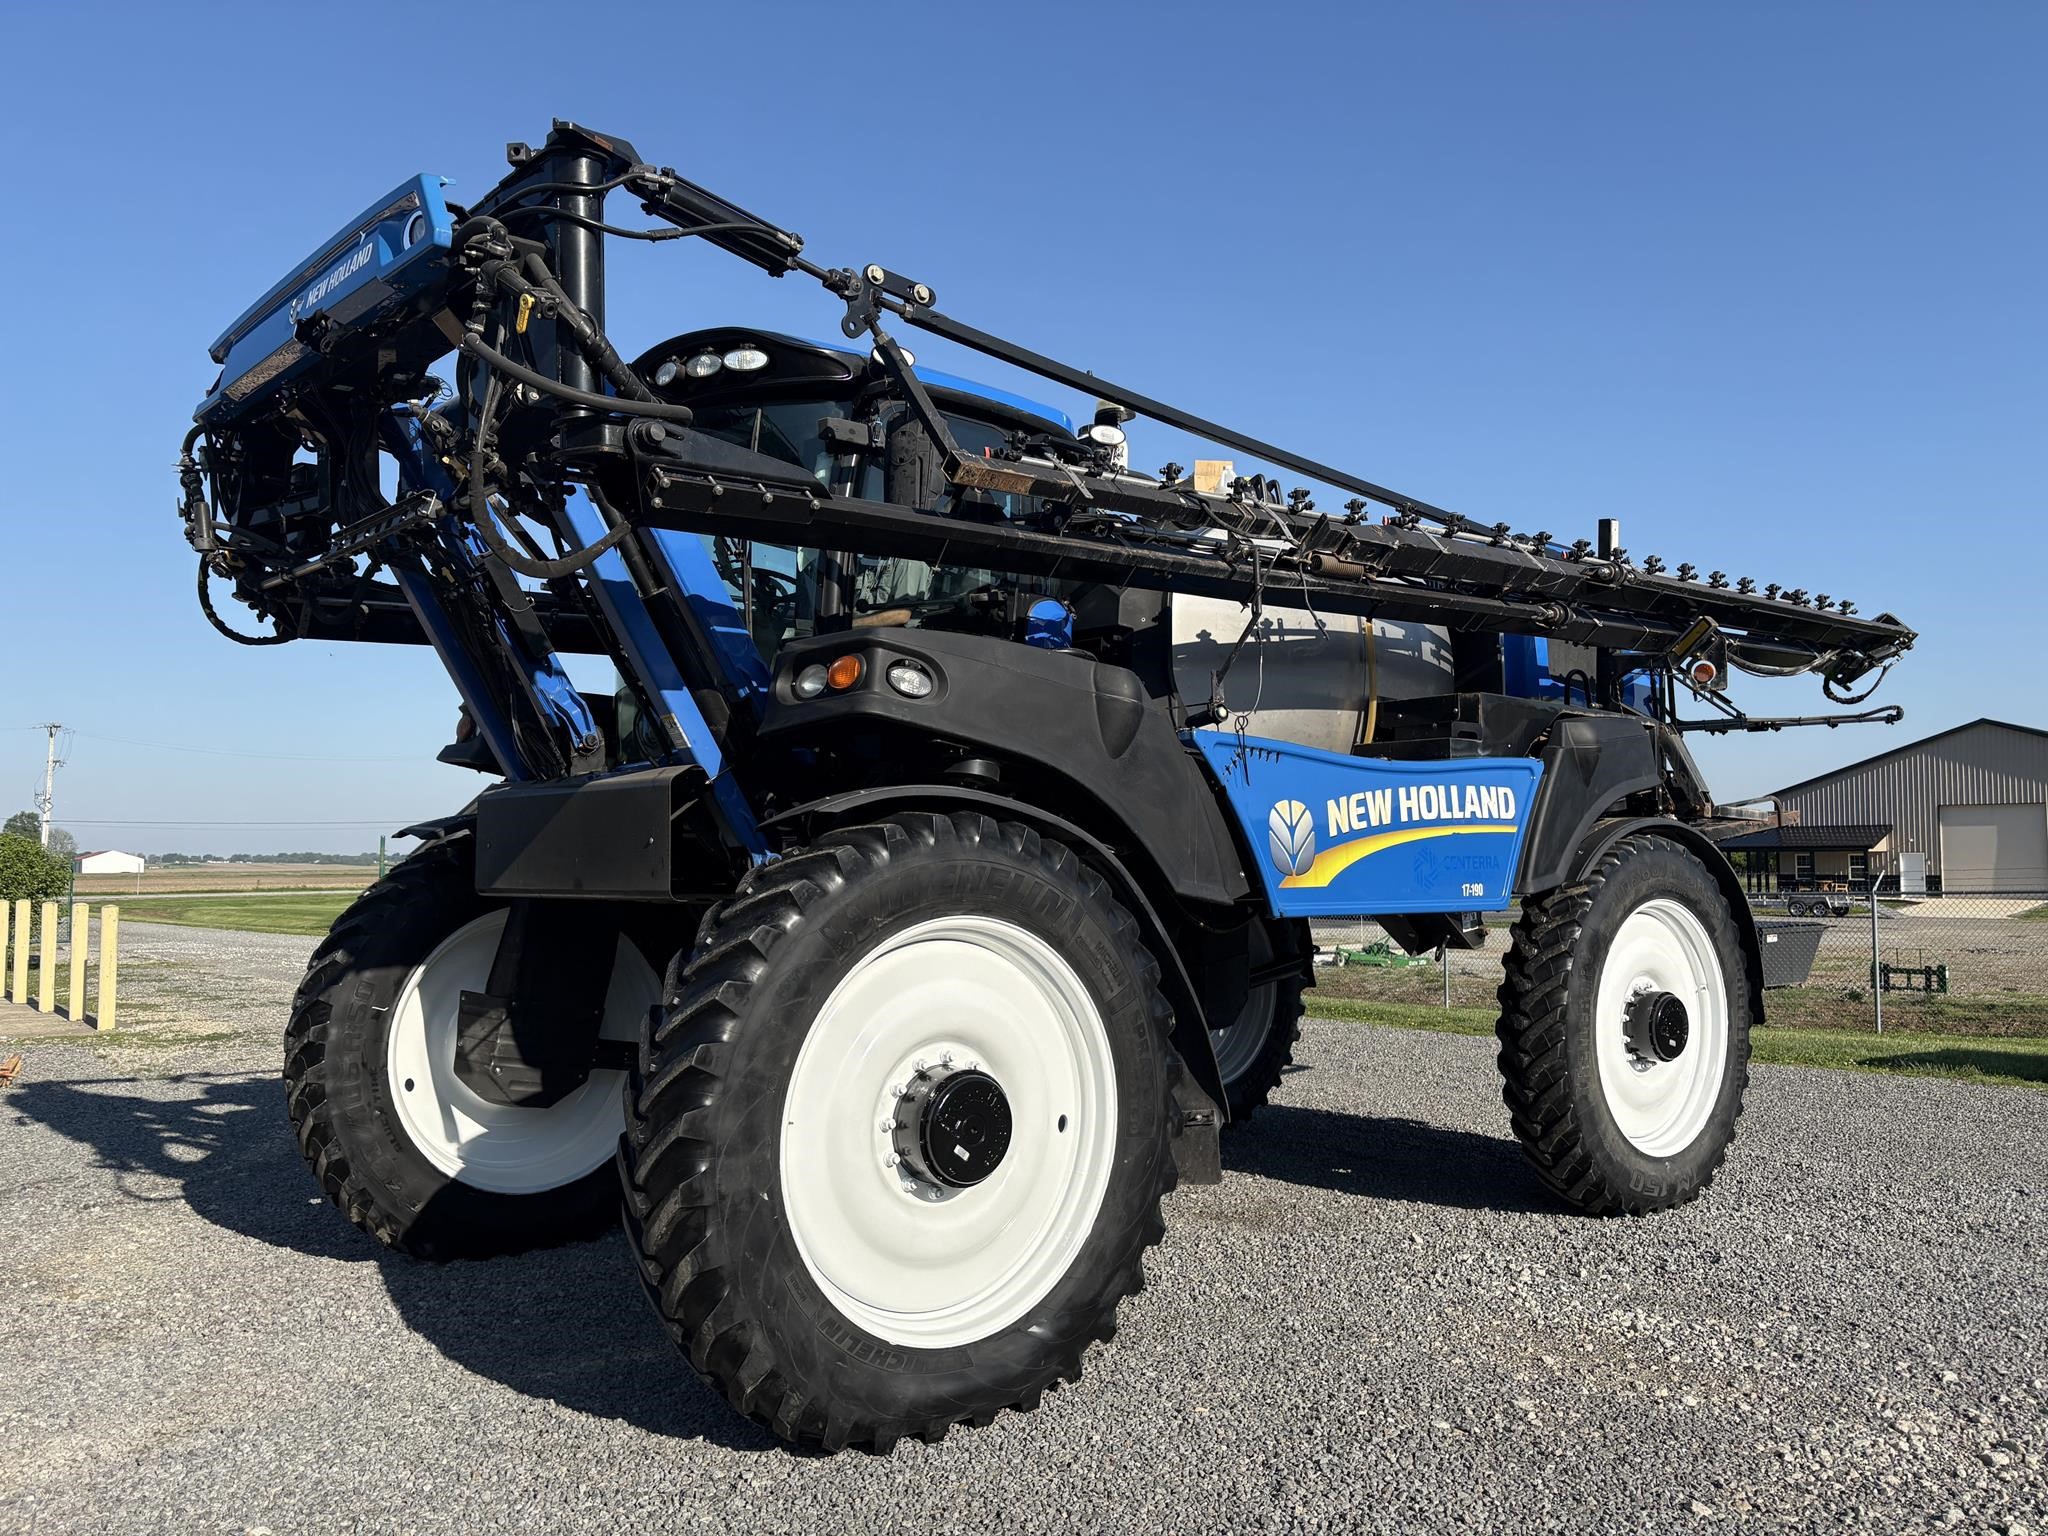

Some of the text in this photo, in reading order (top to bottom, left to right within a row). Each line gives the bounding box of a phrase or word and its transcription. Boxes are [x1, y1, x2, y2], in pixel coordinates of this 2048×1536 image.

[306, 242, 373, 309] NEW HOLLAND
[1327, 785, 1516, 838] NEW HOLLAND
[1443, 855, 1500, 870] CENTERRA
[1462, 883, 1484, 897] 17-190
